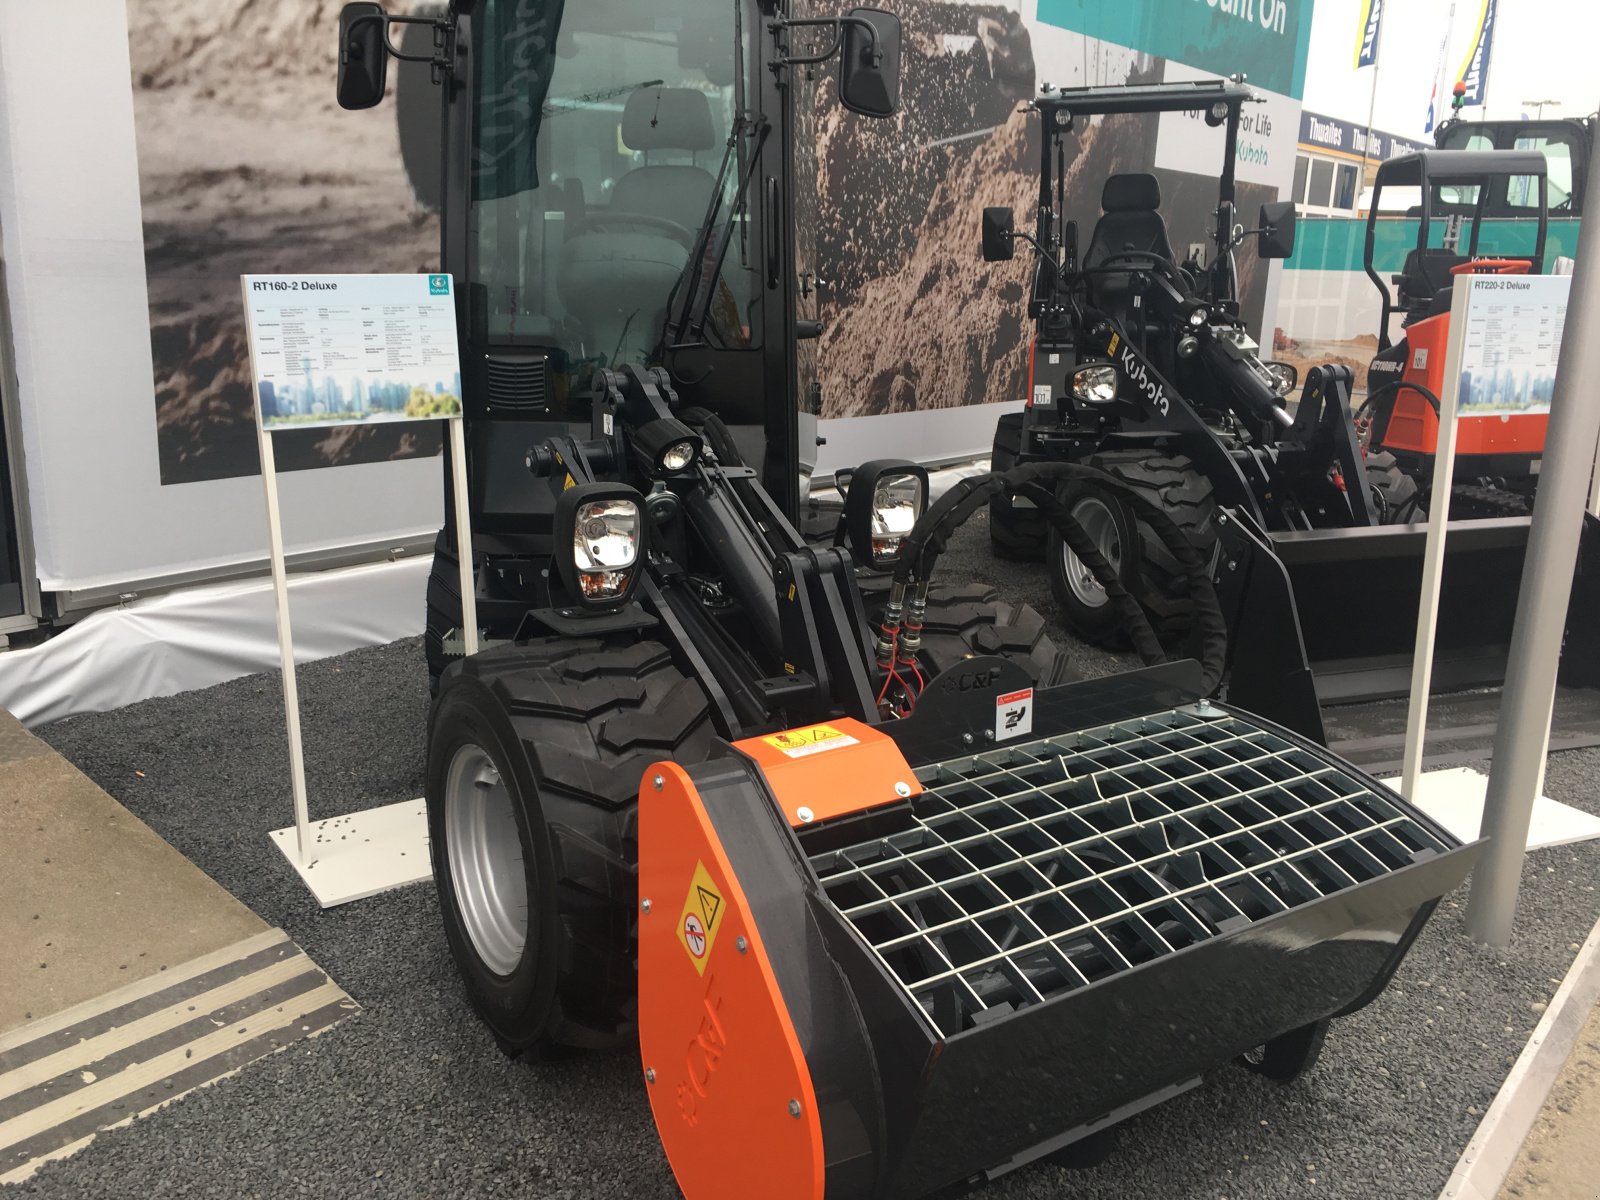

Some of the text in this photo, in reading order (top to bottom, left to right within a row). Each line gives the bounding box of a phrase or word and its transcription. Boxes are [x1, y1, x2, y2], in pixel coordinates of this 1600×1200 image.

[1259, 0, 1287, 35] On
[1256, 113, 1272, 137] Life
[1309, 117, 1342, 146] Thwaites
[1353, 128, 1381, 156] Thwites
[1235, 139, 1268, 166] Kubota
[253, 281, 337, 291] RT160-2 Deluxe
[1474, 281, 1531, 290] RT220-2 Deluxe
[1121, 346, 1170, 416] Kubota
